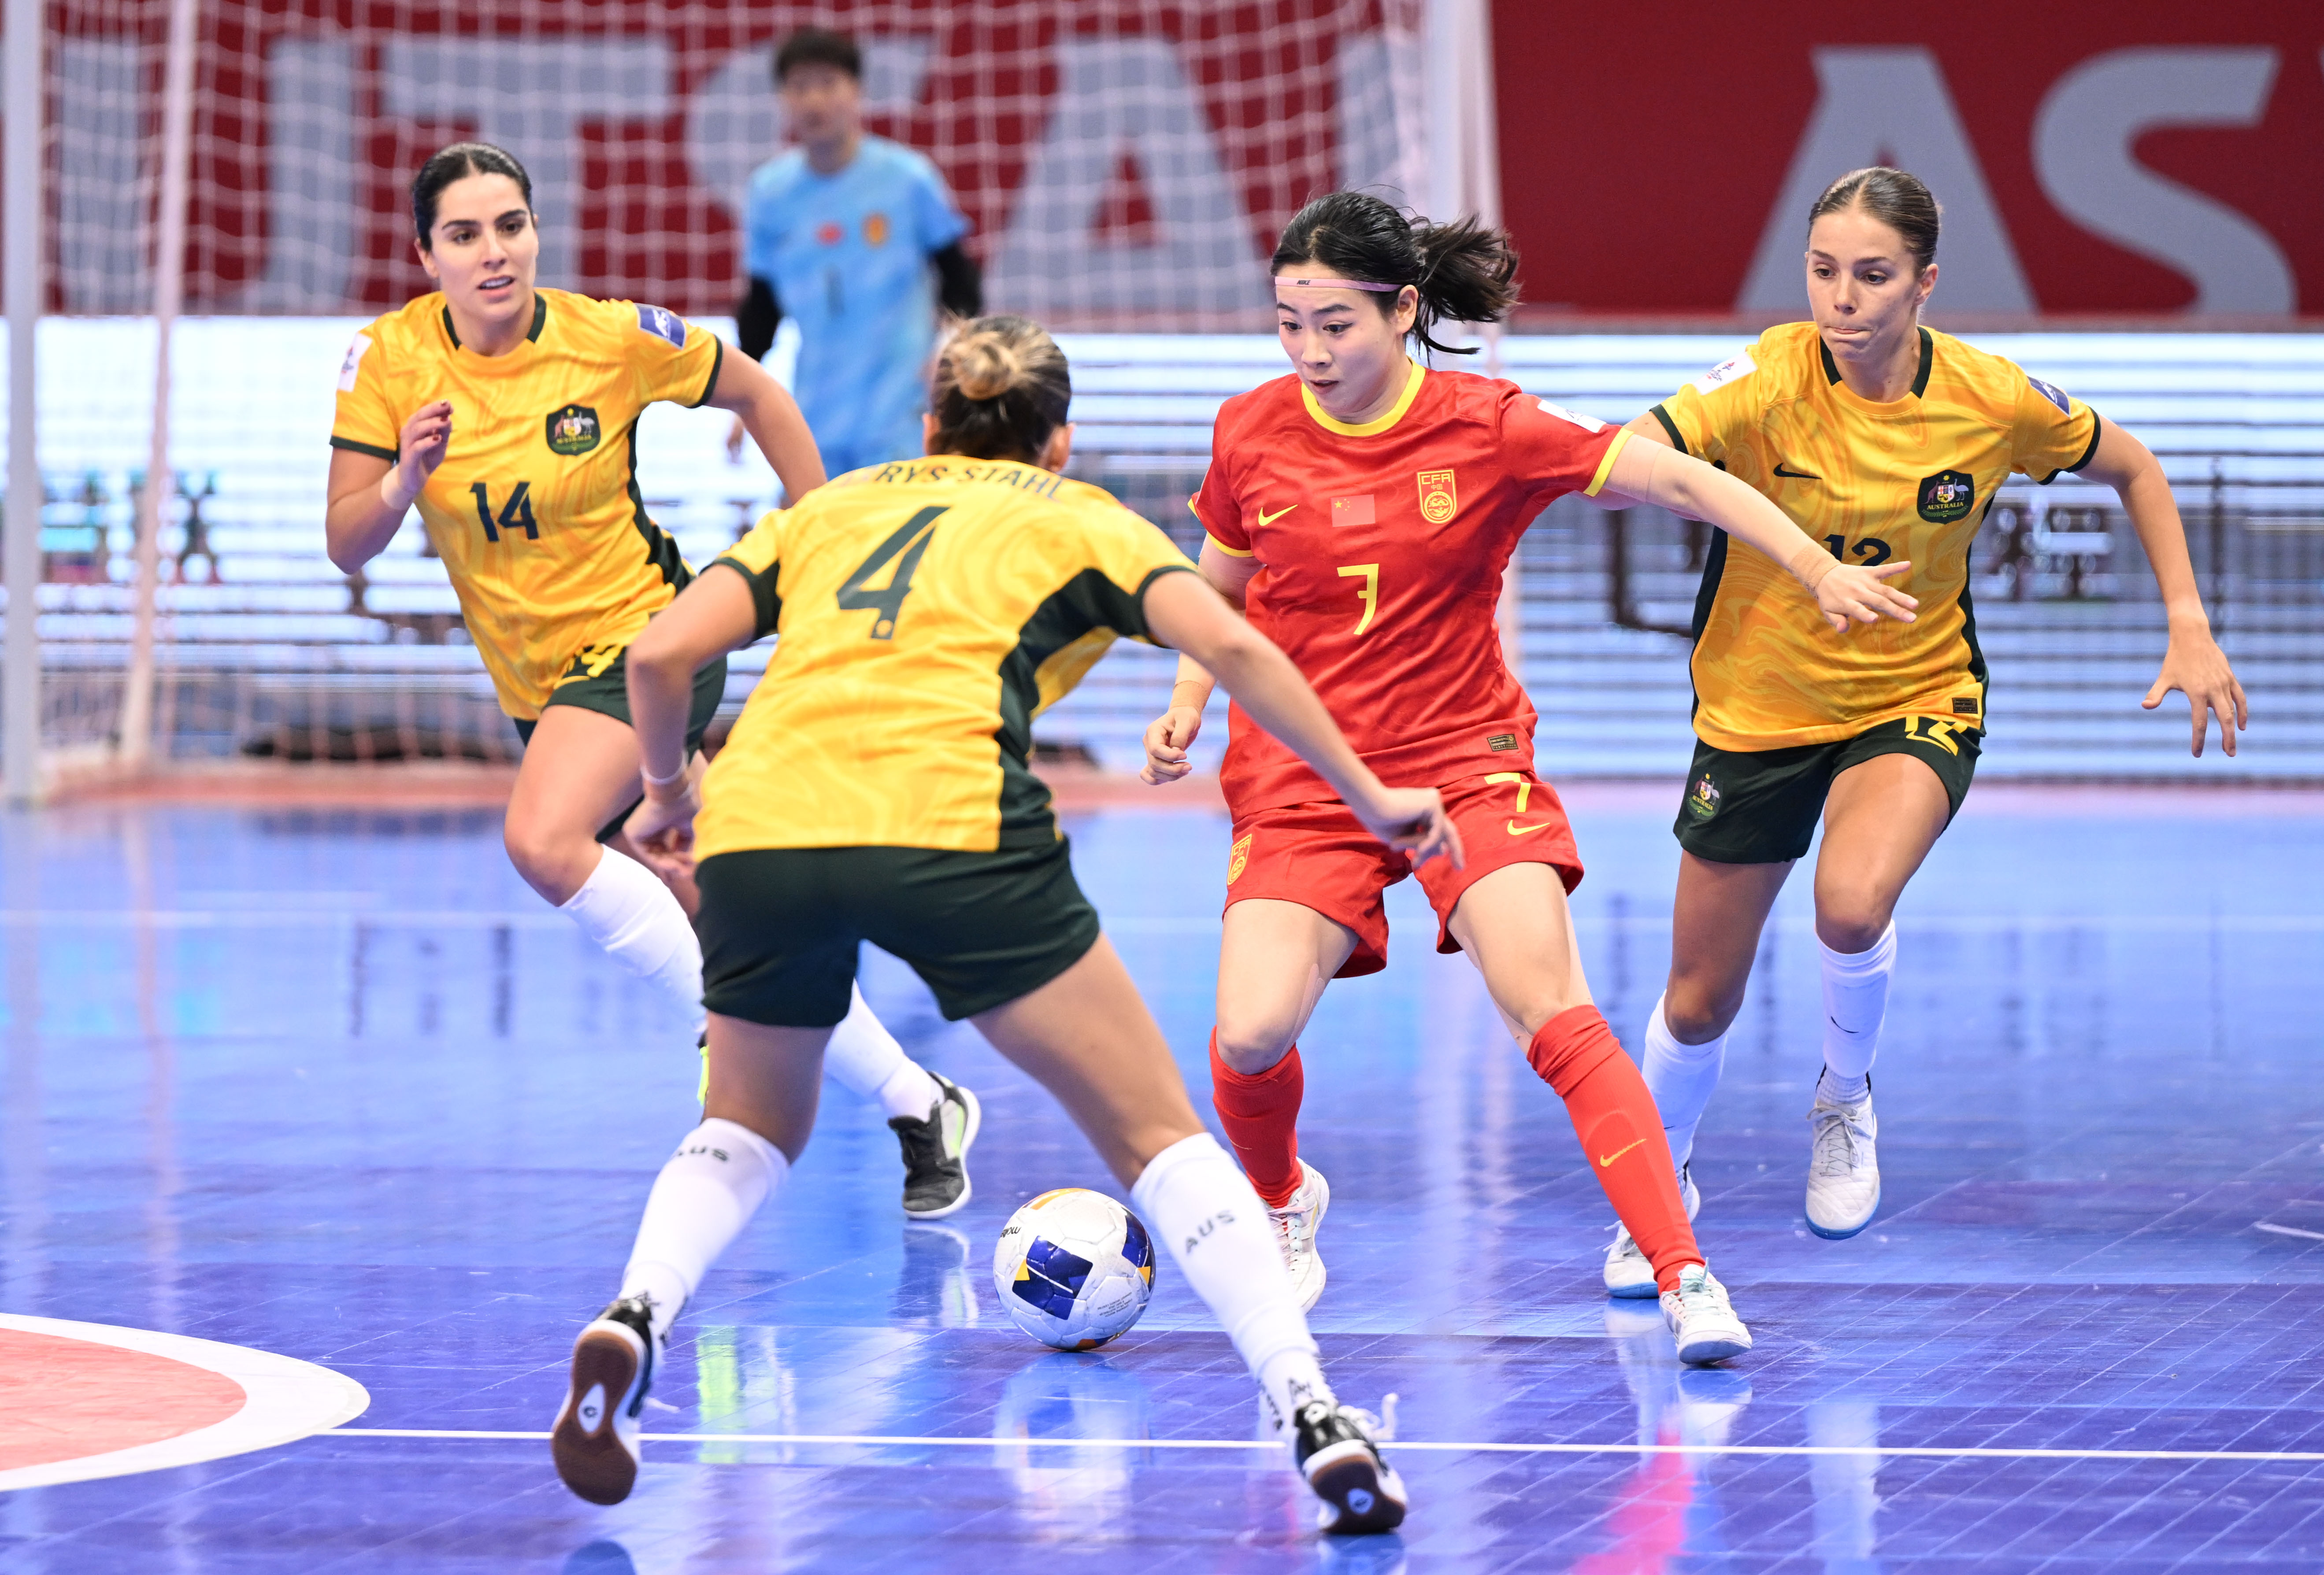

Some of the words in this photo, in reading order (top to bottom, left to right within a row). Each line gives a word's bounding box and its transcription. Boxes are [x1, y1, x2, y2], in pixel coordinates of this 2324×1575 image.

[1734, 43, 2324, 314] AS
[1421, 473, 1451, 484] CFA
[470, 481, 539, 542] 14
[1927, 502, 1964, 510] AUSTRALIA
[836, 506, 951, 640] 4
[1337, 563, 1379, 635] 7
[1483, 772, 1531, 813] 7
[1233, 838, 1250, 856] CFA
[1186, 1209, 1235, 1254] AUS
